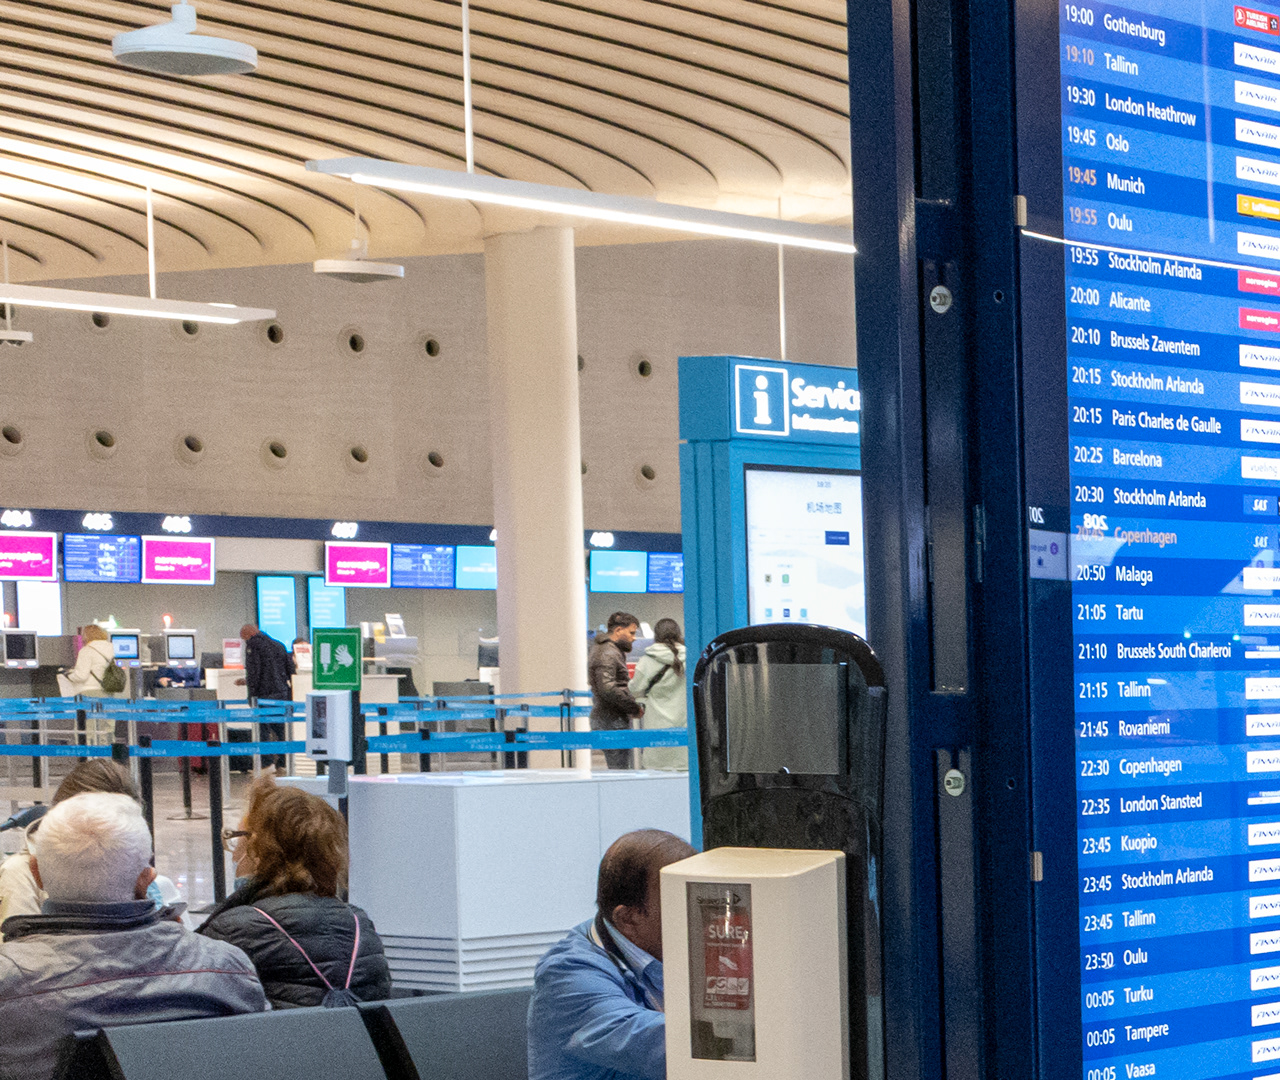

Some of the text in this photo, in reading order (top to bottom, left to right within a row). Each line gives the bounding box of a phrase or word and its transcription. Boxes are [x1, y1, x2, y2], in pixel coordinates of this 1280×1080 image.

[1065, 4, 1094, 26] 19:00
[1104, 14, 1166, 47] Gothenburg
[1065, 45, 1094, 66] 19:10
[1104, 52, 1139, 76] Tallinn
[1067, 85, 1096, 106] 19:30
[1106, 93, 1144, 116] London
[1147, 102, 1196, 126] Heathrow
[1105, 132, 1130, 153] Oslo
[1068, 166, 1097, 186] 19:45
[1106, 172, 1145, 195] Munich
[1107, 212, 1133, 232] Oulu
[1109, 251, 1202, 280] Stockholm Arlanda
[1070, 286, 1151, 313] 20:00 Alicante
[1071, 326, 1101, 346] 20:10
[1111, 331, 1149, 350] Brussels
[1152, 335, 1200, 356] Zaventem
[1111, 370, 1204, 394] Stockholm Arlanda
[1112, 409, 1221, 433] Paris Charles de Gaulle
[1074, 445, 1103, 464] 20:25
[1113, 448, 1163, 468] Barcelona
[1114, 488, 1166, 505] Stockholm
[1168, 491, 1206, 507] Arlanda
[1114, 529, 1177, 547] Copenhagen
[1077, 564, 1153, 587] 20:50 Malaga
[1115, 604, 1144, 621] Tartu
[1078, 643, 1108, 660] 21:10
[1118, 643, 1156, 658] Brussels
[1158, 643, 1186, 658] South
[1189, 642, 1231, 658] Charleroi
[1118, 682, 1151, 697] Tallinn
[1118, 717, 1170, 738] Rovaniemi
[1119, 756, 1182, 778] Copenhagen
[1081, 798, 1111, 816] 22:35
[1120, 795, 1158, 813] London
[1161, 792, 1202, 810] Stansted
[1120, 833, 1158, 854] Kuopio
[1122, 870, 1173, 889] Stockholm
[1176, 866, 1213, 884] Arlanda
[1121, 909, 1156, 927] Tallinn
[708, 925, 743, 939] SURE
[1085, 951, 1115, 970] 23:50
[1123, 947, 1148, 966] Oulu
[1123, 985, 1154, 1003] Turku
[1124, 1023, 1169, 1042] Tampere
[1125, 1063, 1156, 1079] Vaasa
